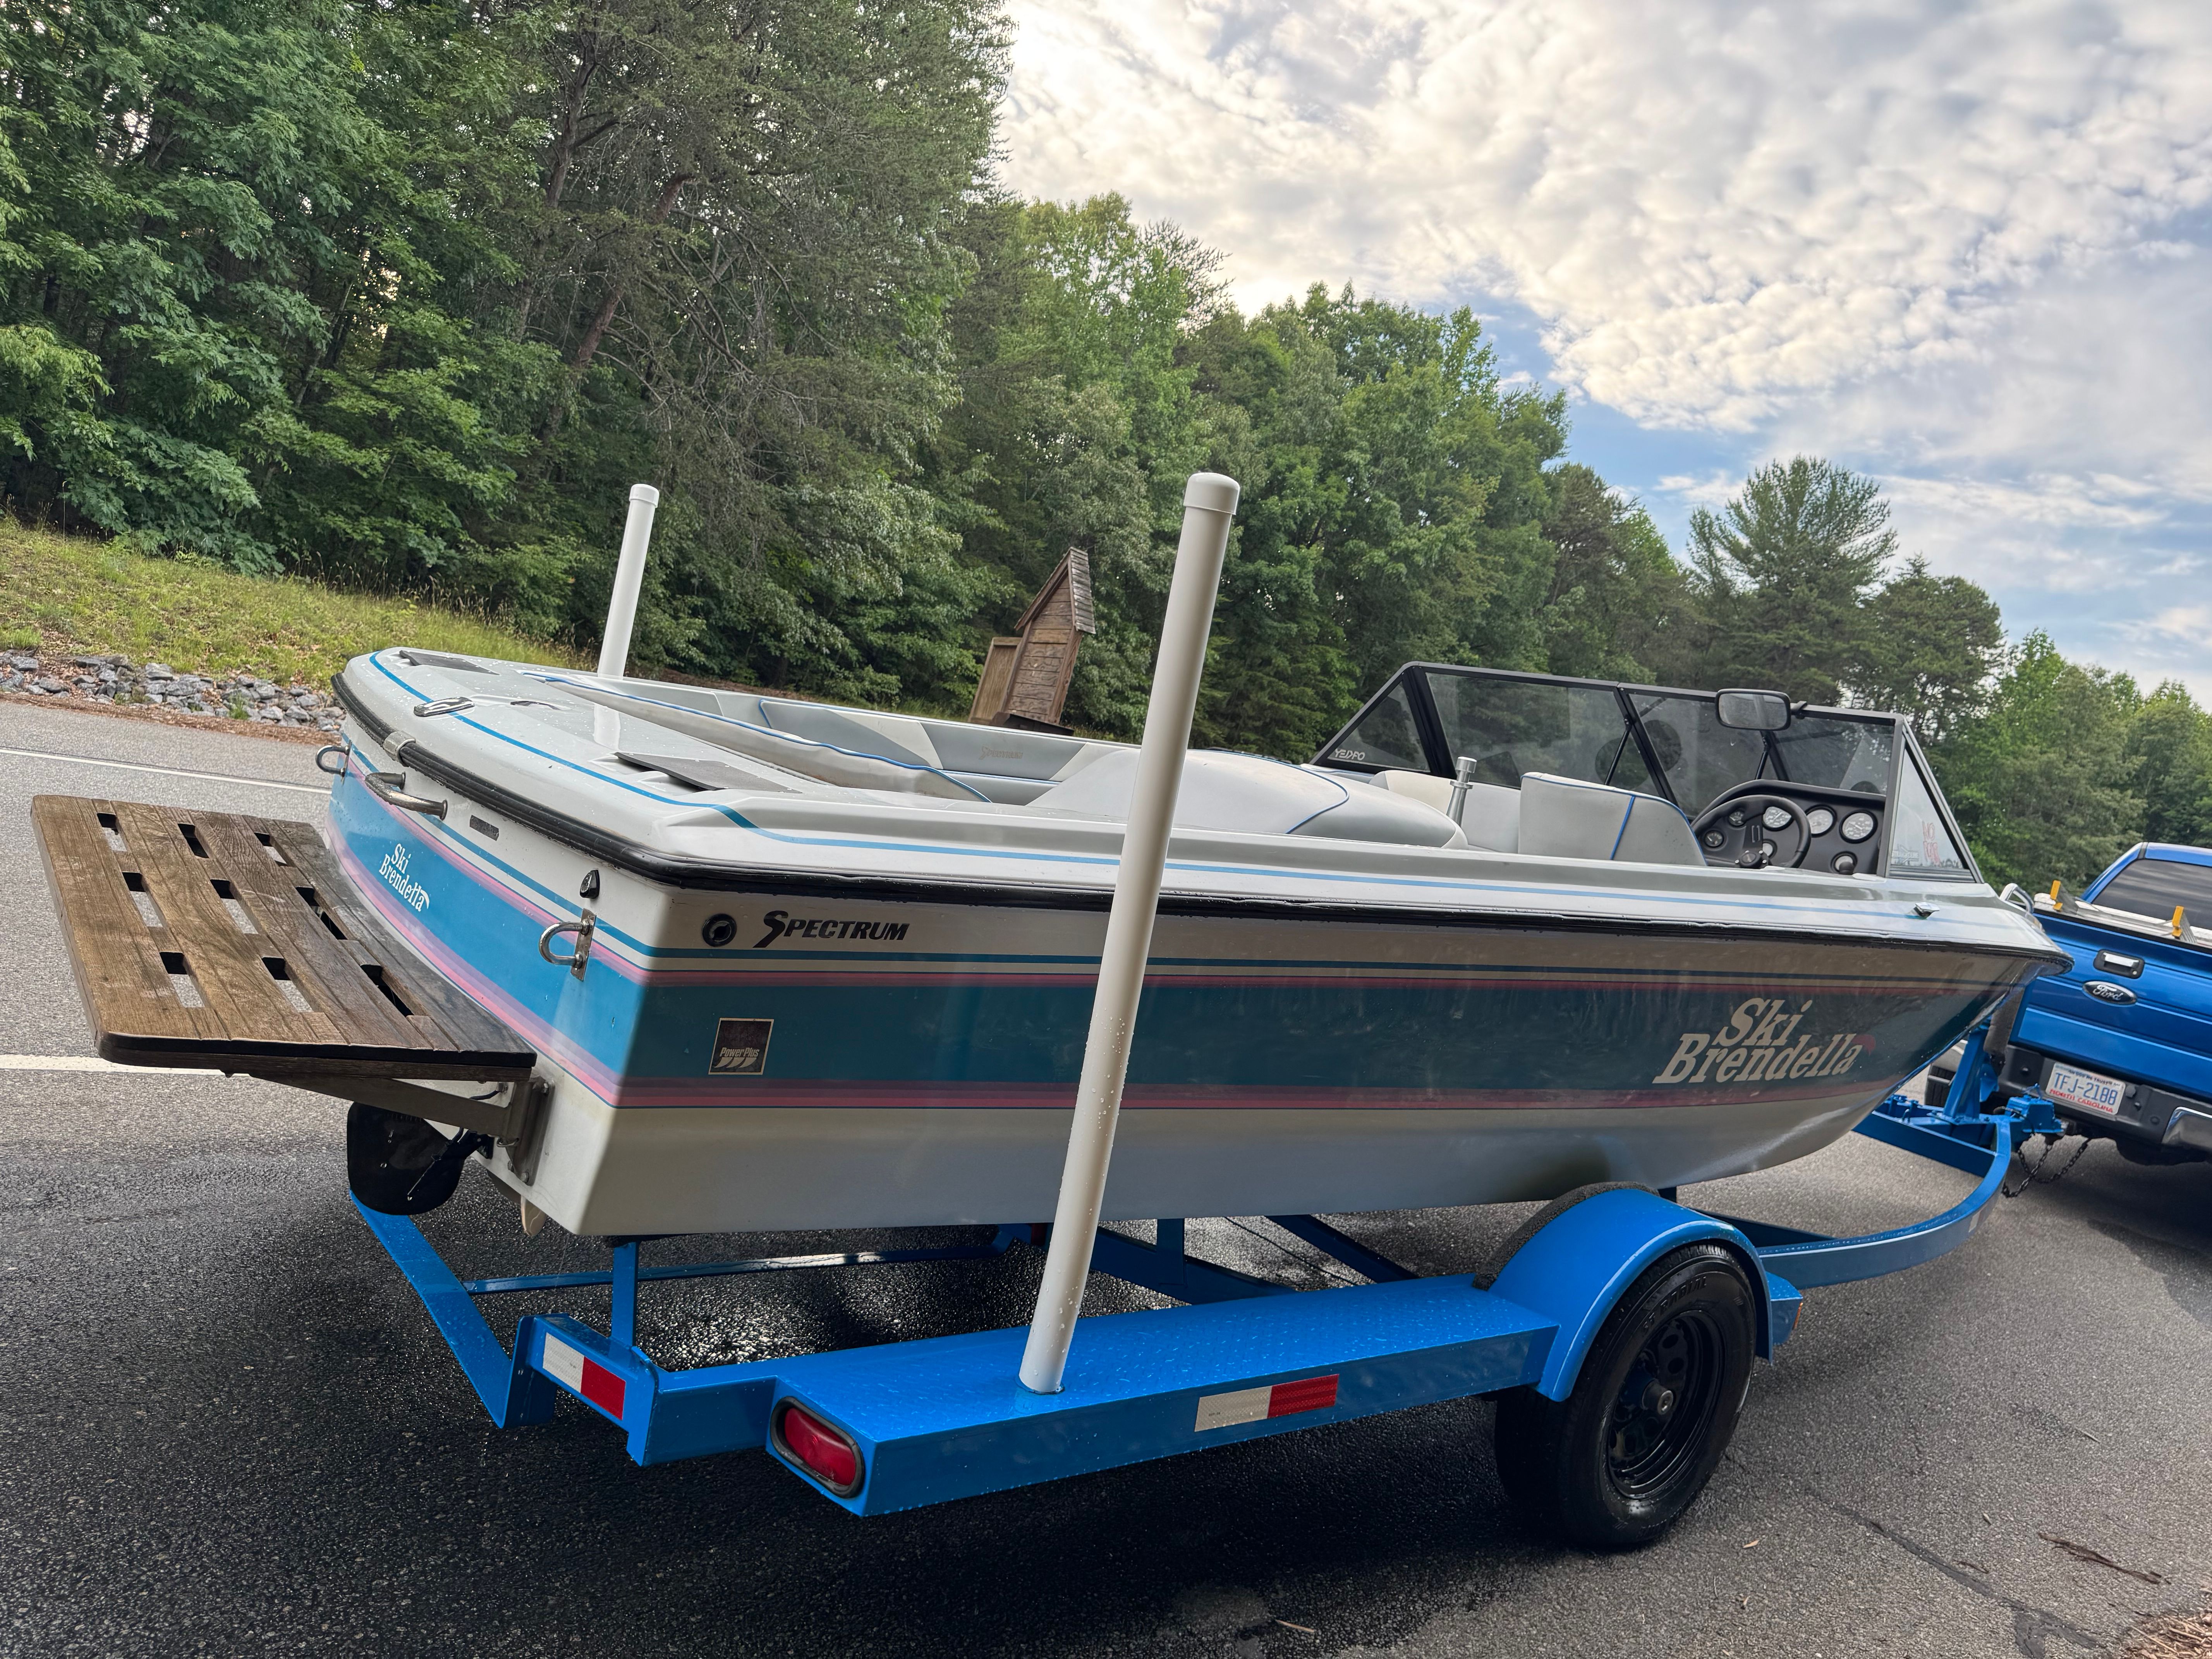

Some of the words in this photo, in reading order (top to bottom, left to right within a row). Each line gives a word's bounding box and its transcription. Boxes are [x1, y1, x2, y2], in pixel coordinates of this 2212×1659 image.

[391, 843, 411, 874] Ski
[752, 910, 910, 948] SPECTRUM
[2092, 984, 2124, 1000] Ford
[1712, 998, 1813, 1046] Ski
[1652, 1033, 1862, 1084] Brendella
[2050, 1089, 2075, 1101] NORTH
[2077, 1097, 2113, 1113] CAROLINA
[2054, 1073, 2118, 1105] TFJ-2188
